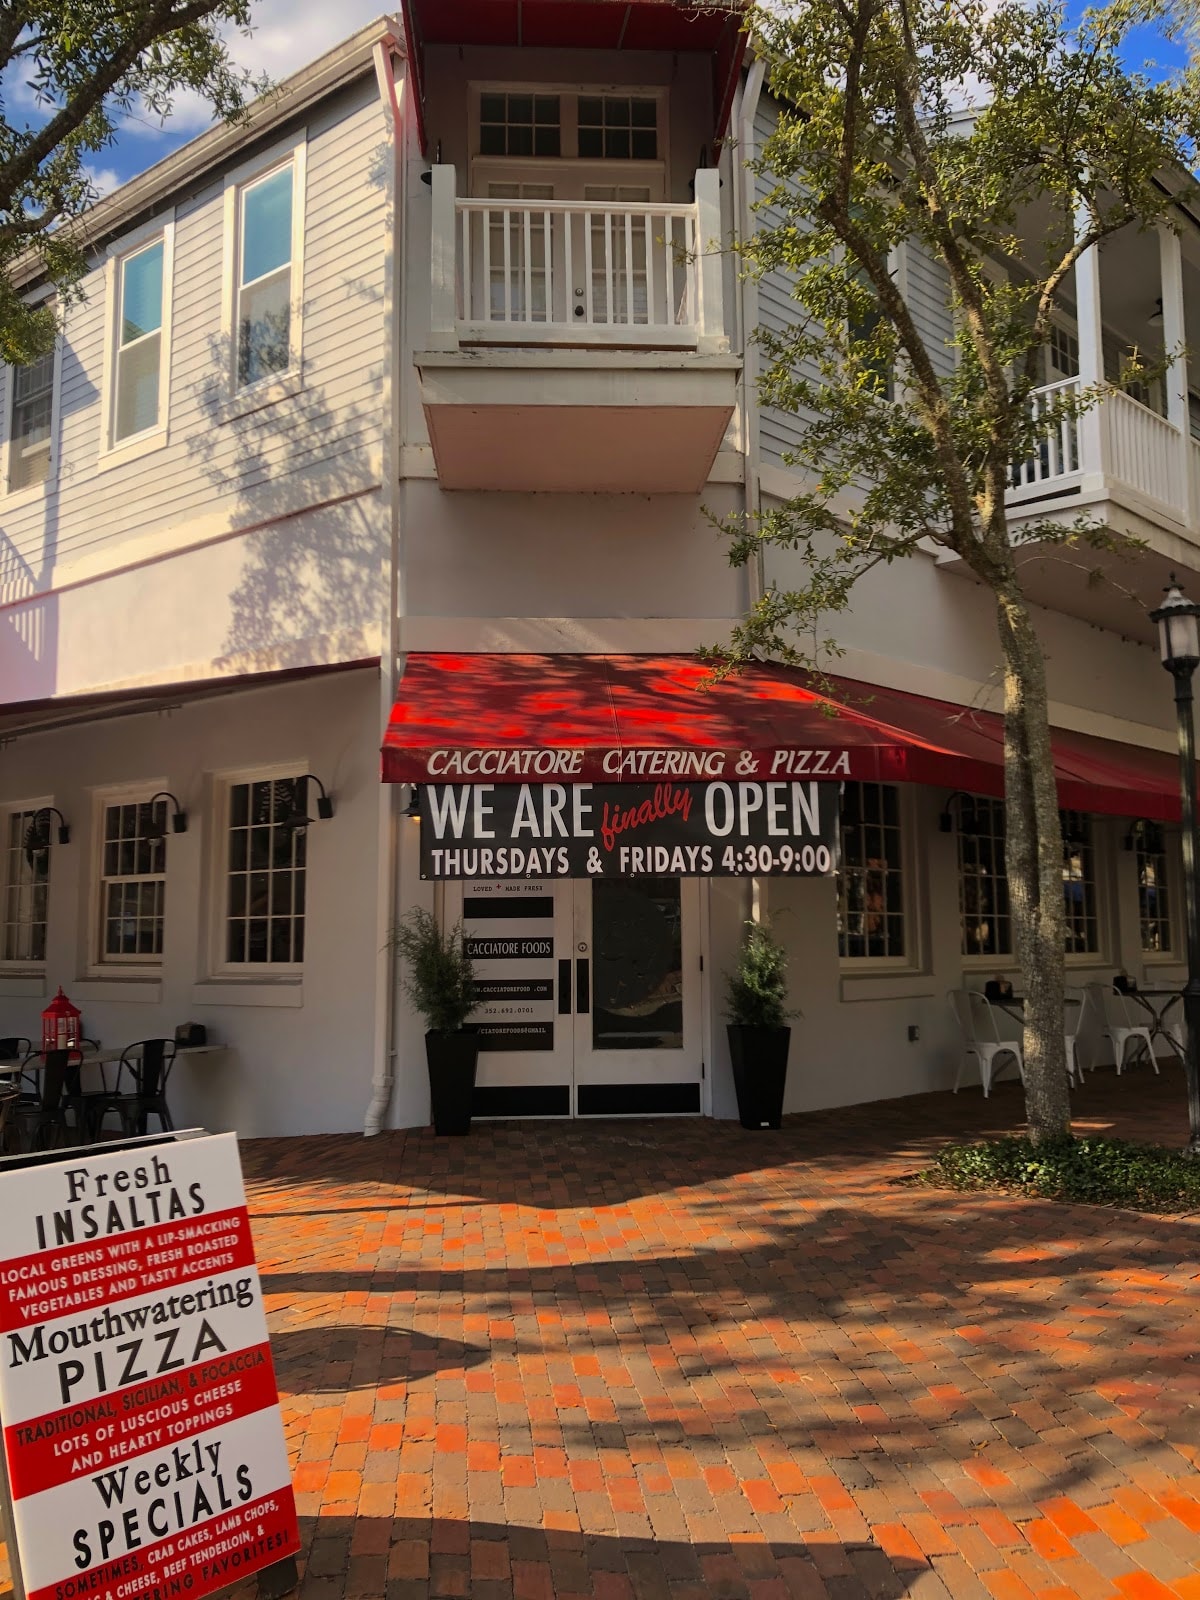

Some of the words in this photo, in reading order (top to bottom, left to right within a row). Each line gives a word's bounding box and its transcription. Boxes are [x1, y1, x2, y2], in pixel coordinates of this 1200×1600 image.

[427, 749, 584, 776] CACCIATORE
[602, 750, 726, 776] CATERING
[734, 751, 760, 775] &
[770, 750, 852, 776] PIZZA
[427, 783, 495, 840] WE
[510, 783, 595, 839] ARE
[600, 782, 694, 853] finally
[704, 781, 821, 837] OPEN
[431, 847, 570, 876] THURSDAYS
[586, 846, 604, 874] &
[619, 845, 714, 874] FRIDAYS
[721, 844, 831, 874] 4:30-9:00
[467, 942, 519, 955] CACCIATORE
[522, 942, 551, 954] FOODS
[63, 1154, 173, 1204] Fresh
[0, 1262, 47, 1285] LOCAL
[50, 1249, 105, 1272] GREENS
[107, 1240, 141, 1259] WITH
[144, 1238, 155, 1250] A
[157, 1216, 241, 1247] LIP-SMACKING
[35, 1182, 206, 1250] INSALTAS
[8, 1276, 68, 1303] FAMOUS
[72, 1259, 143, 1288] DRESSING,
[147, 1247, 184, 1268] FRESH
[187, 1234, 240, 1258] ROASTED
[20, 1286, 105, 1320] VEGETABLES
[108, 1277, 137, 1297] AND
[140, 1267, 178, 1288] TASTY
[181, 1252, 235, 1276] ACCENTS
[7, 1277, 254, 1369] Mouthwatering
[57, 1317, 228, 1405] PIZZA
[15, 1401, 118, 1448] TRADITIONAL,
[122, 1378, 185, 1413] SICILIAN,
[188, 1372, 199, 1388] &
[201, 1352, 266, 1384] FOCACCIA
[53, 1433, 90, 1457] LOTS
[95, 1423, 116, 1443] OF
[120, 1399, 190, 1434] LUSCIOUS
[193, 1379, 243, 1407] CHEESE
[70, 1451, 104, 1474] AND
[108, 1429, 163, 1459] HEARTY
[166, 1403, 234, 1437] TOPPINGS
[91, 1439, 222, 1509] Weekly
[55, 1555, 145, 1600] SOMETIMES,
[147, 1544, 175, 1566] CRAB
[177, 1528, 214, 1553] CAKES,
[215, 1514, 242, 1536] LAMB
[244, 1499, 280, 1523] CHOPS,
[72, 1464, 254, 1570] SPECIALS
[116, 1571, 161, 1599] CHEESE,
[163, 1559, 187, 1580] BEEF
[190, 1529, 255, 1566] TENDERLOIN,
